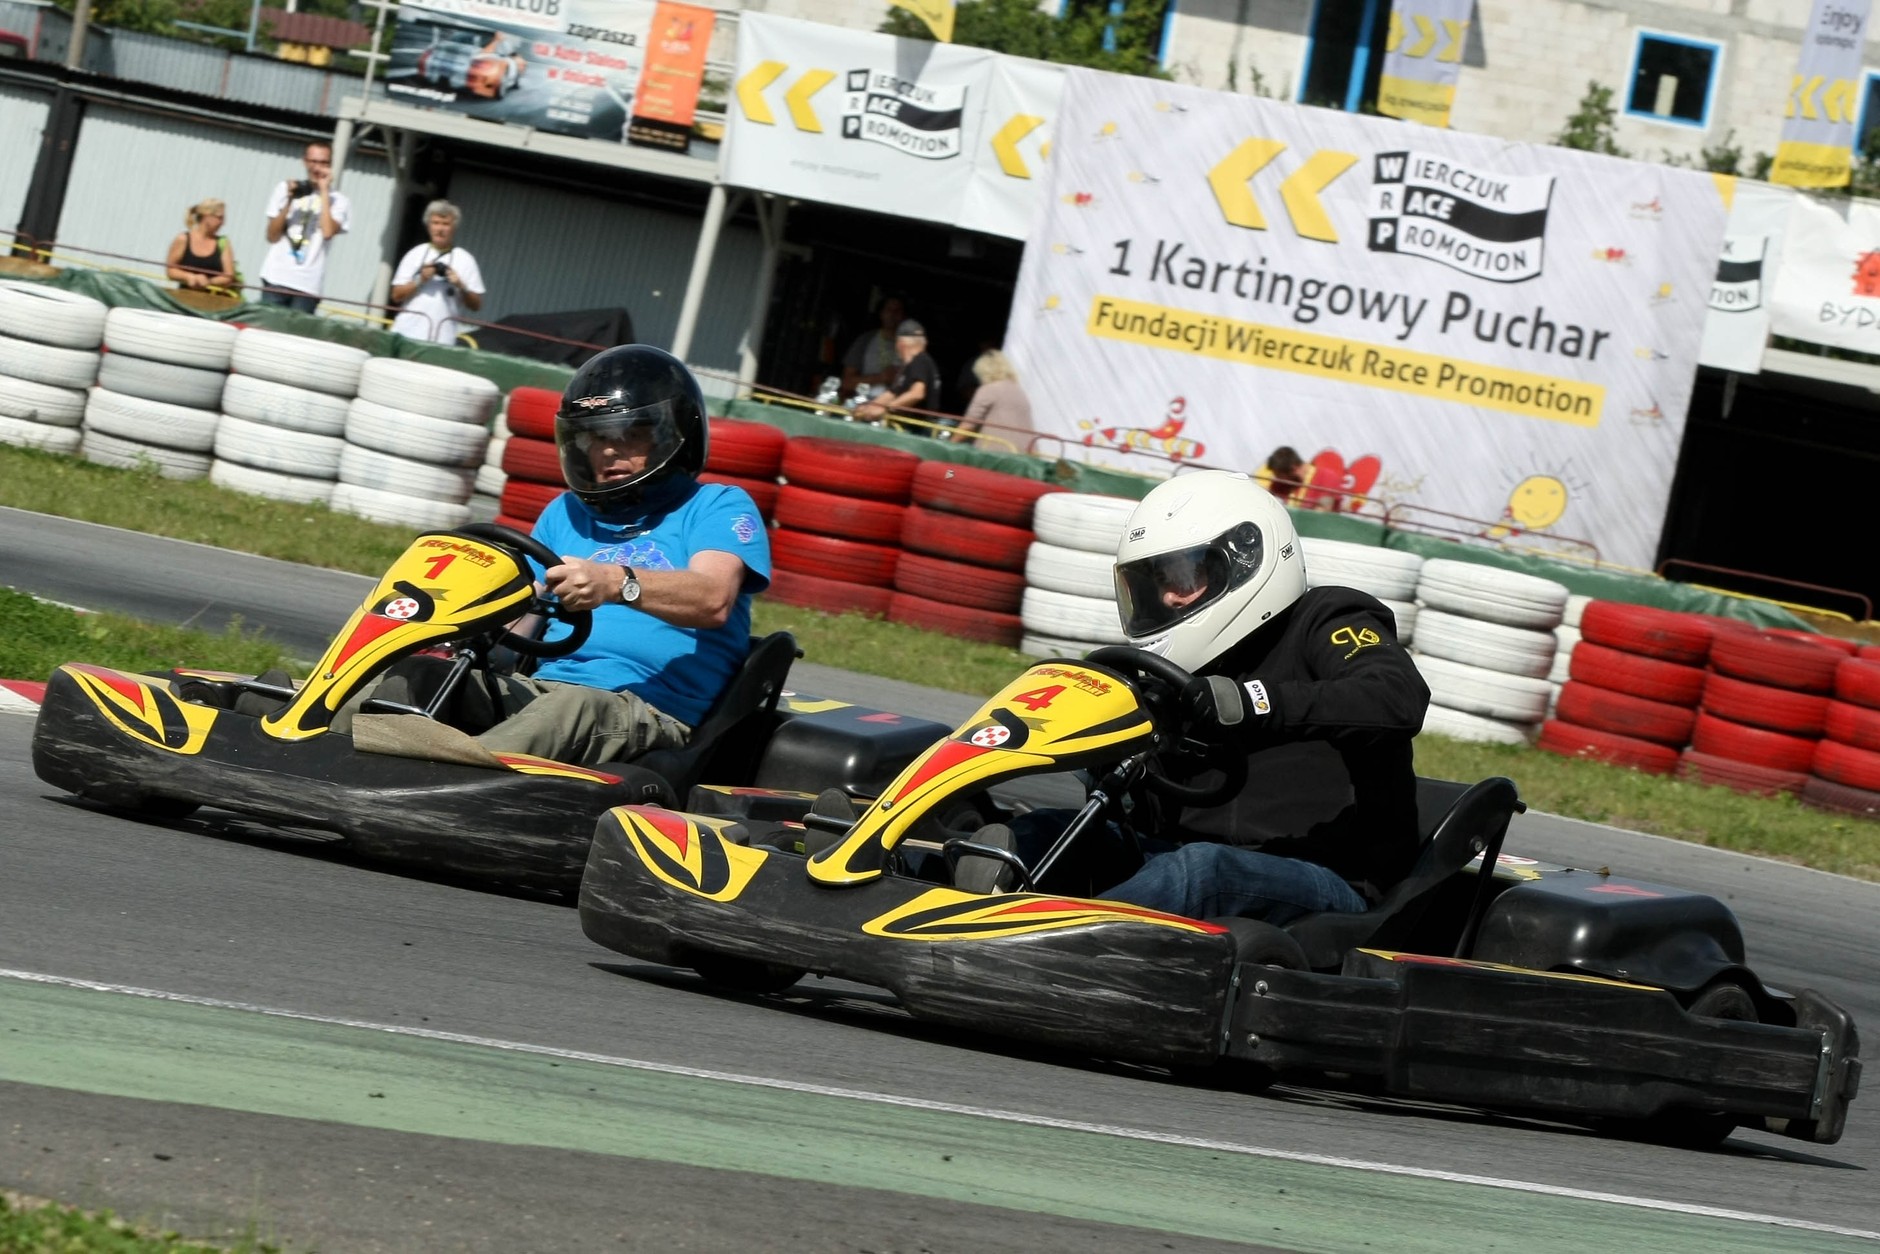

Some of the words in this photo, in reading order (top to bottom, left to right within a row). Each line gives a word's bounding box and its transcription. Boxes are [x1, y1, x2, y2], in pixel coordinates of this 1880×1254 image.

[567, 23, 636, 46] zaprasza
[1109, 238, 1132, 277] 1
[1149, 239, 1430, 341] Kartingowy
[1440, 290, 1611, 361] Puchar
[1819, 301, 1880, 330] BYD
[1094, 301, 1218, 351] Fundacji
[1225, 323, 1355, 372] Wierczuk
[1361, 348, 1429, 385] Race
[1436, 361, 1594, 417] Promotion
[1129, 528, 1146, 541] OMP
[465, 553, 492, 568] KART
[1281, 543, 1294, 559] OMP
[423, 553, 458, 580] 1
[1011, 684, 1068, 712] 4
[1075, 681, 1106, 697] KART
